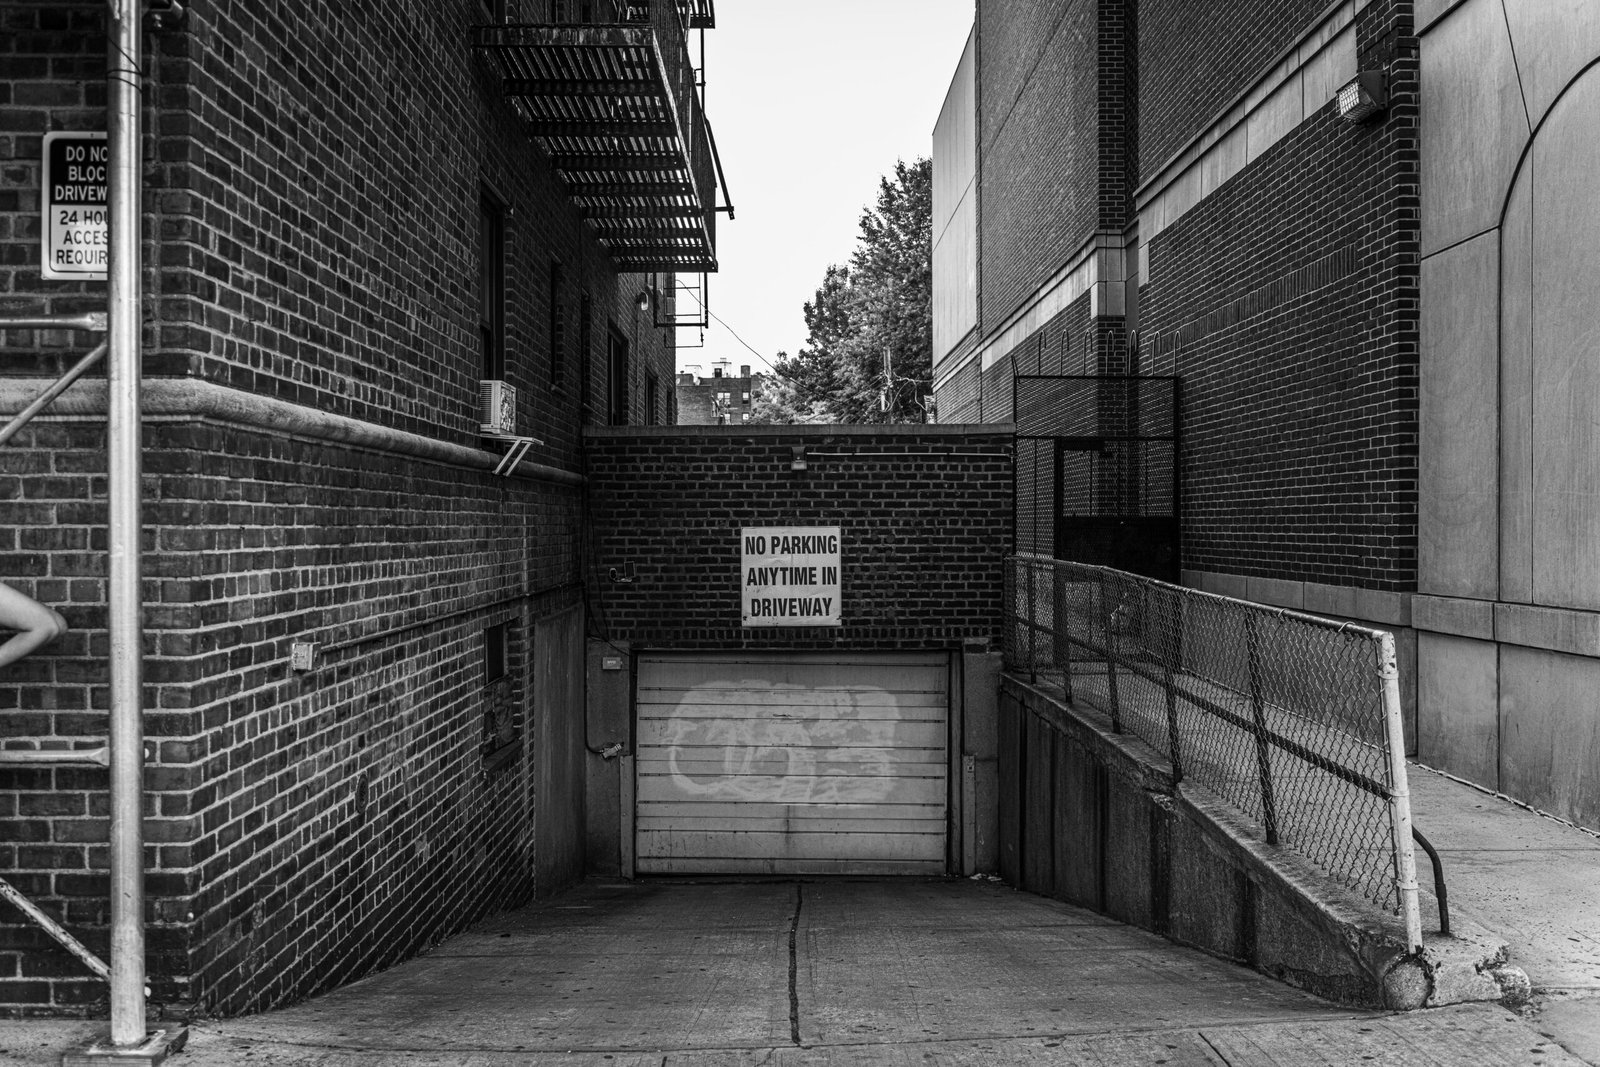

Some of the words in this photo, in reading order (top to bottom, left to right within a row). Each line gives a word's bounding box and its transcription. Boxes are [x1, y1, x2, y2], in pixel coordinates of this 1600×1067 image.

[66, 146, 85, 161] DO
[90, 146, 108, 161] NO
[68, 165, 108, 181] BLOC
[55, 185, 108, 201] DRIVEW
[59, 210, 78, 225] 24
[63, 230, 108, 245] ACCES
[56, 249, 108, 265] REQUIR
[745, 536, 766, 555] NO
[771, 535, 838, 555] PARKING
[746, 566, 817, 586] ANYTIME
[822, 566, 837, 585] IN
[751, 597, 832, 617] DRIVEWAY
